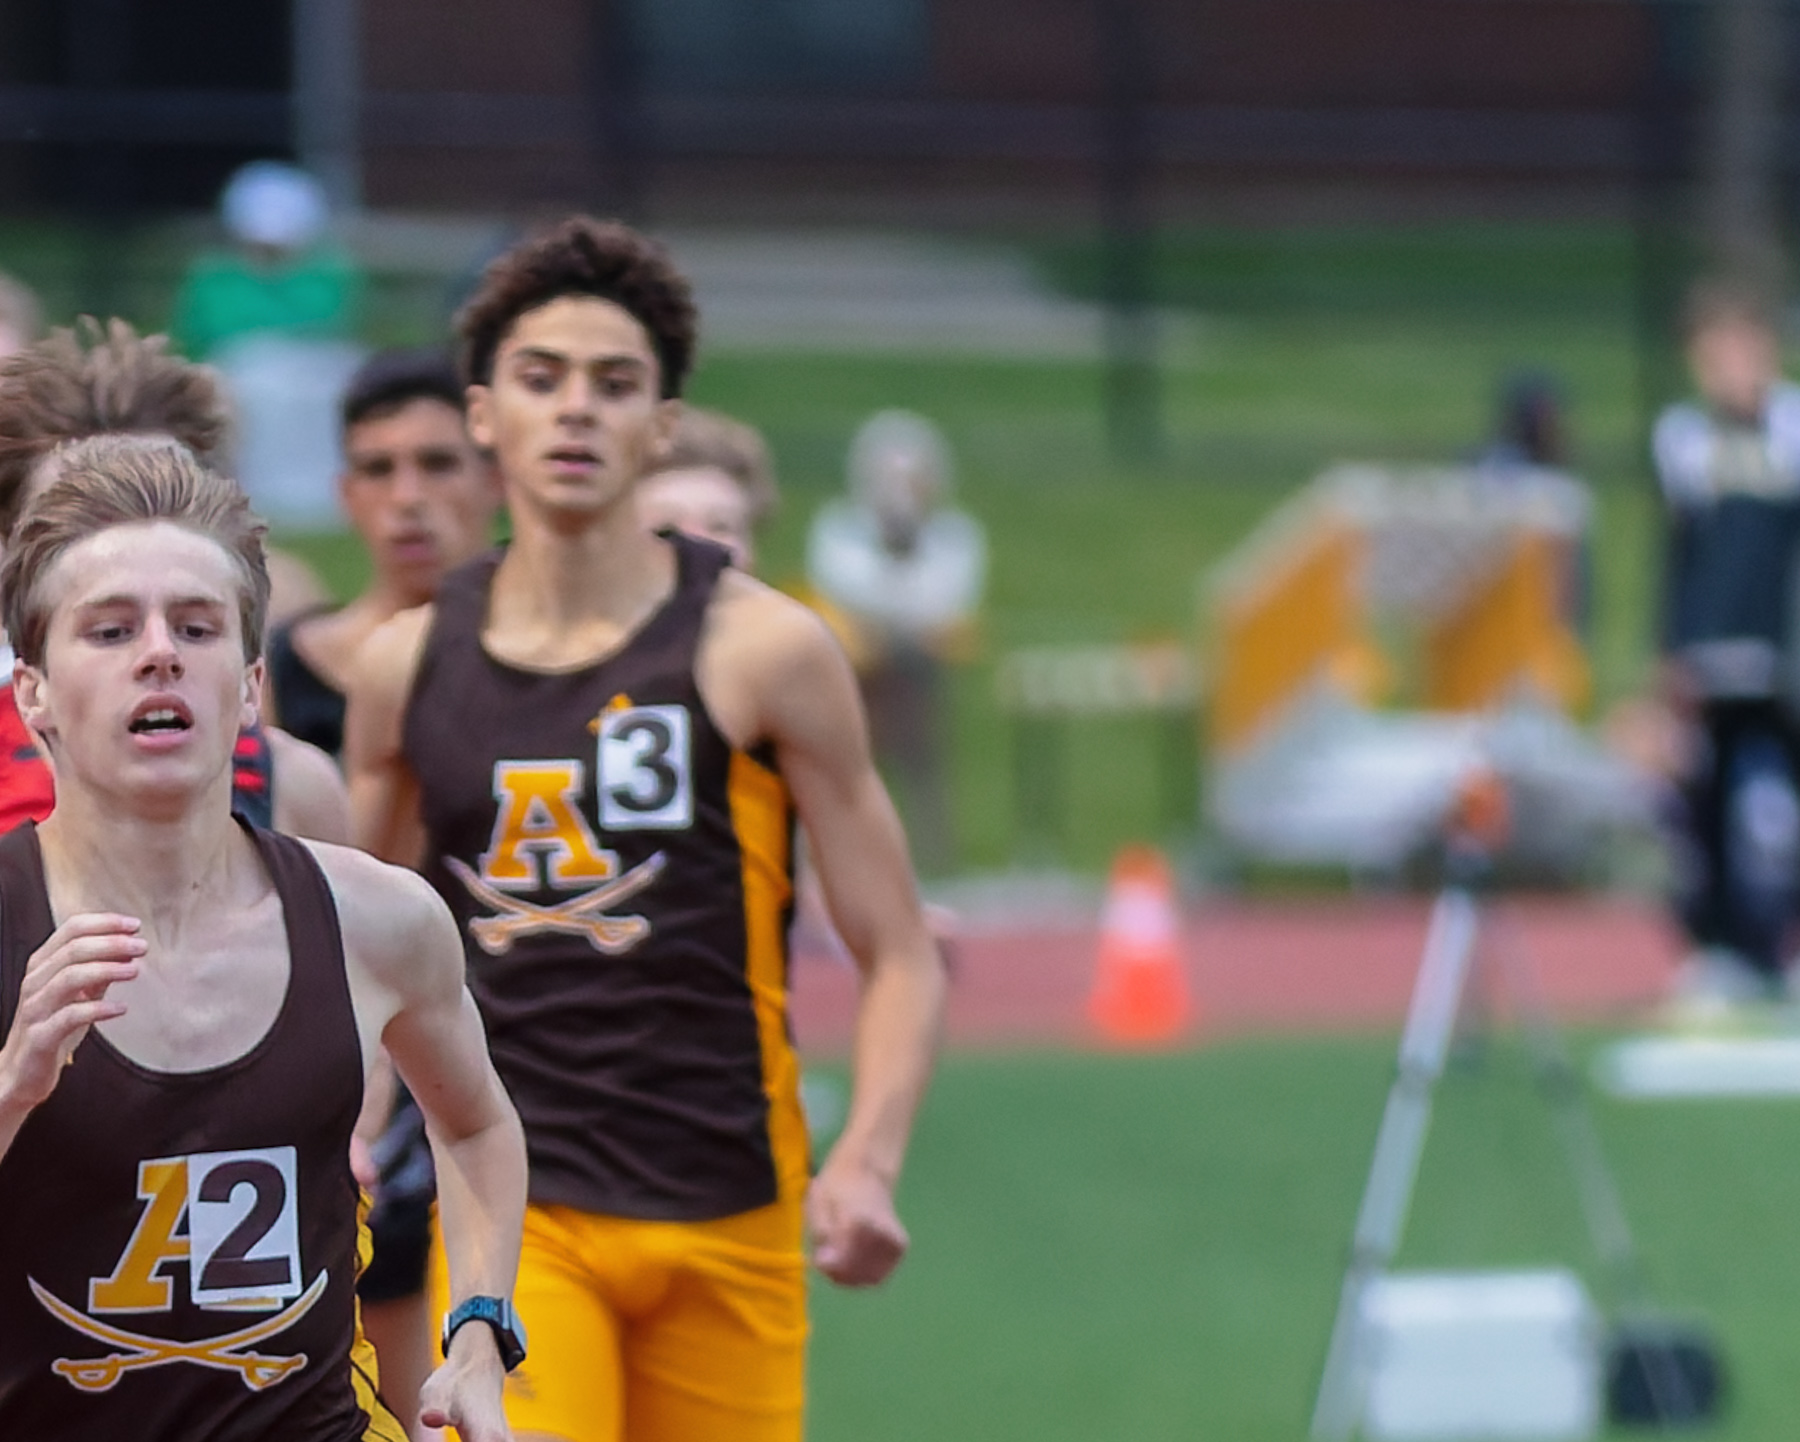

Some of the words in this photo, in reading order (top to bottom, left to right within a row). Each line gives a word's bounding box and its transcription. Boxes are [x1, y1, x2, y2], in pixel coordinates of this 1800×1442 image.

[478, 759, 621, 891] A
[607, 719, 679, 812] 3
[197, 1158, 292, 1291] 2
